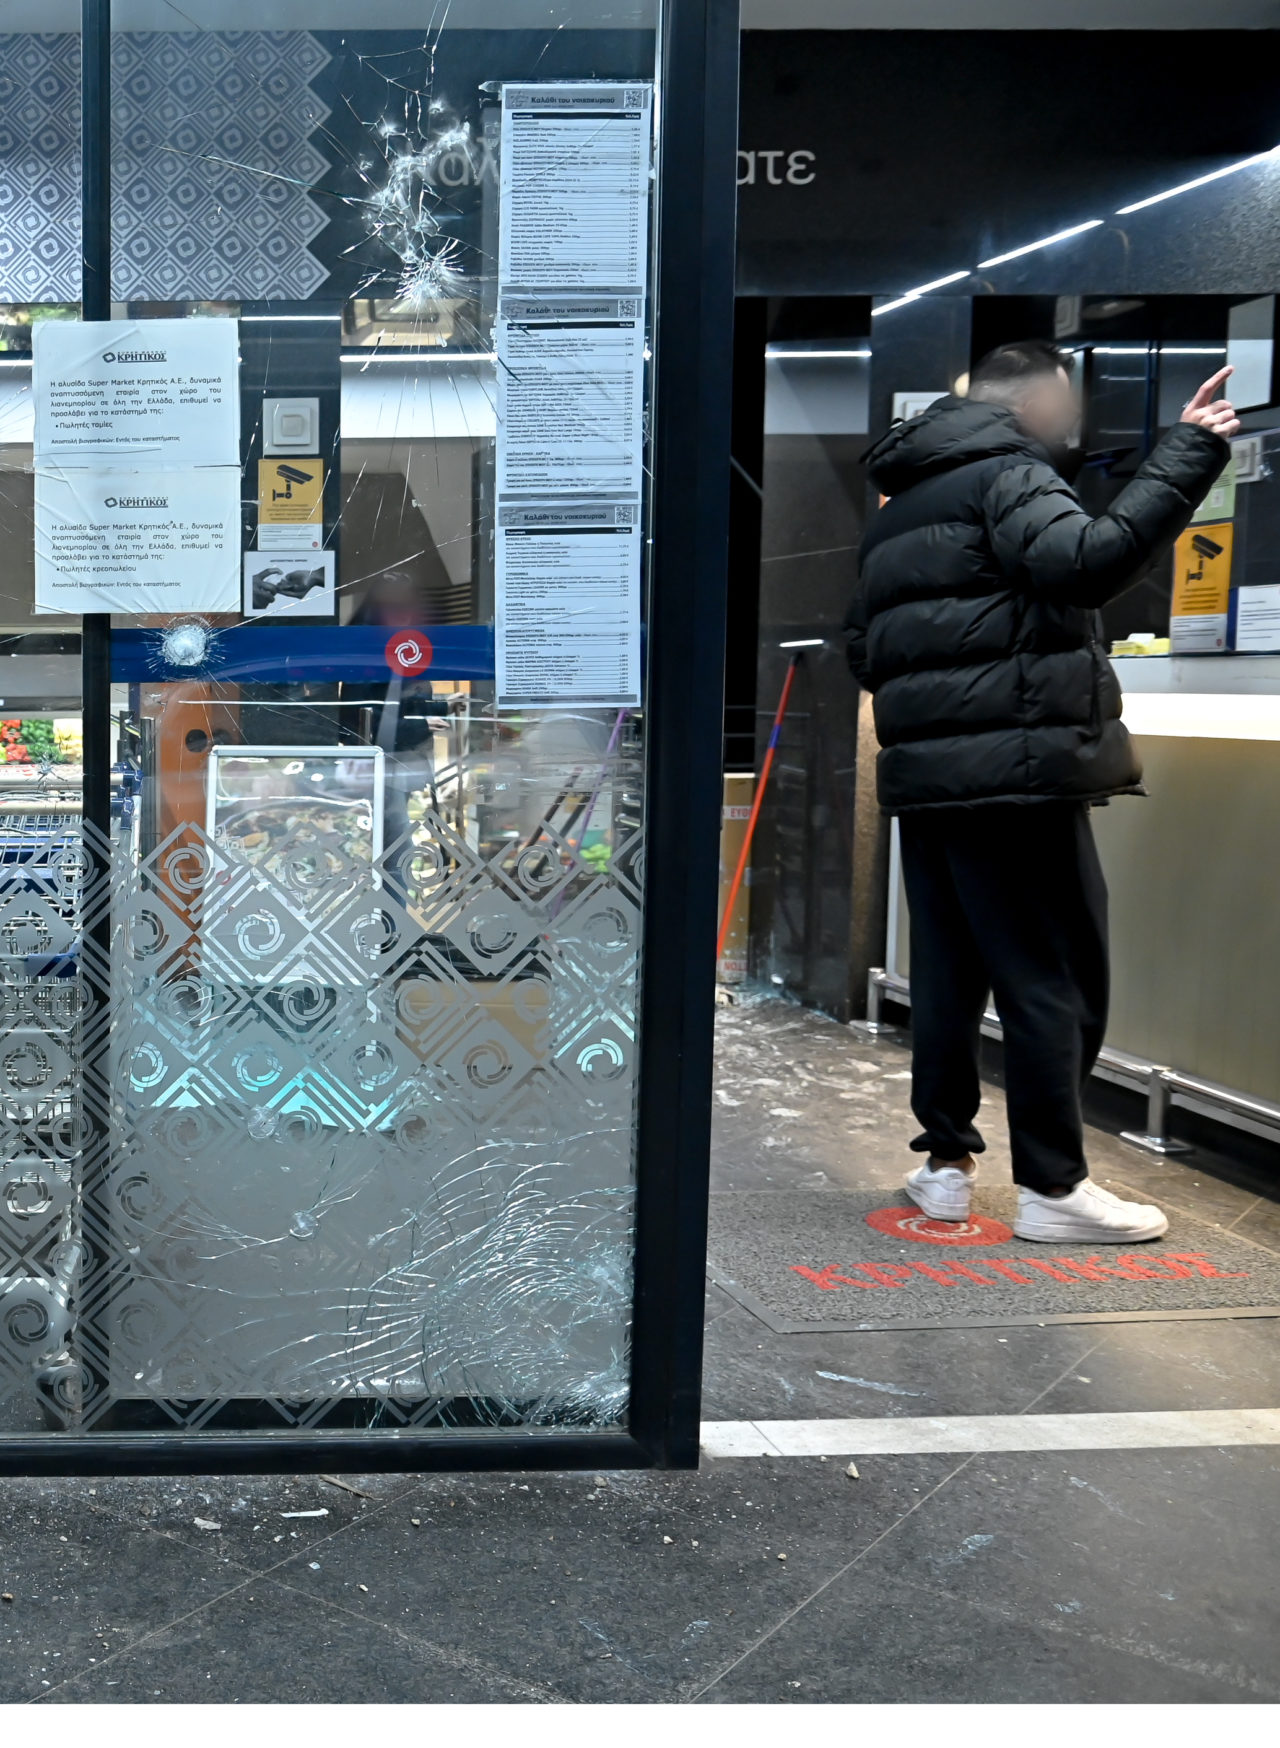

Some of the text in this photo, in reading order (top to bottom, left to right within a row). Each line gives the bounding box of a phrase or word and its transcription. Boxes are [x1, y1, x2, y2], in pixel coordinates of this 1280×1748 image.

[118, 352, 167, 361] ΚΡΗΤΙΚΟΣ
[88, 379, 108, 387] Super
[137, 378, 168, 386] Κρητικός
[179, 387, 198, 395] χώρο
[113, 399, 126, 407] όλη
[60, 421, 113, 430] Πωλητές ταμίες
[119, 499, 169, 507] ΚΡΗΤΙΚΟΣ
[139, 523, 170, 531] Κρητικός
[191, 522, 224, 530] δυναμικά
[181, 533, 200, 541] χώρο
[114, 543, 128, 551] όλη
[789, 1252, 1249, 1290] ΚΡΗΤΙΚΟΣ
